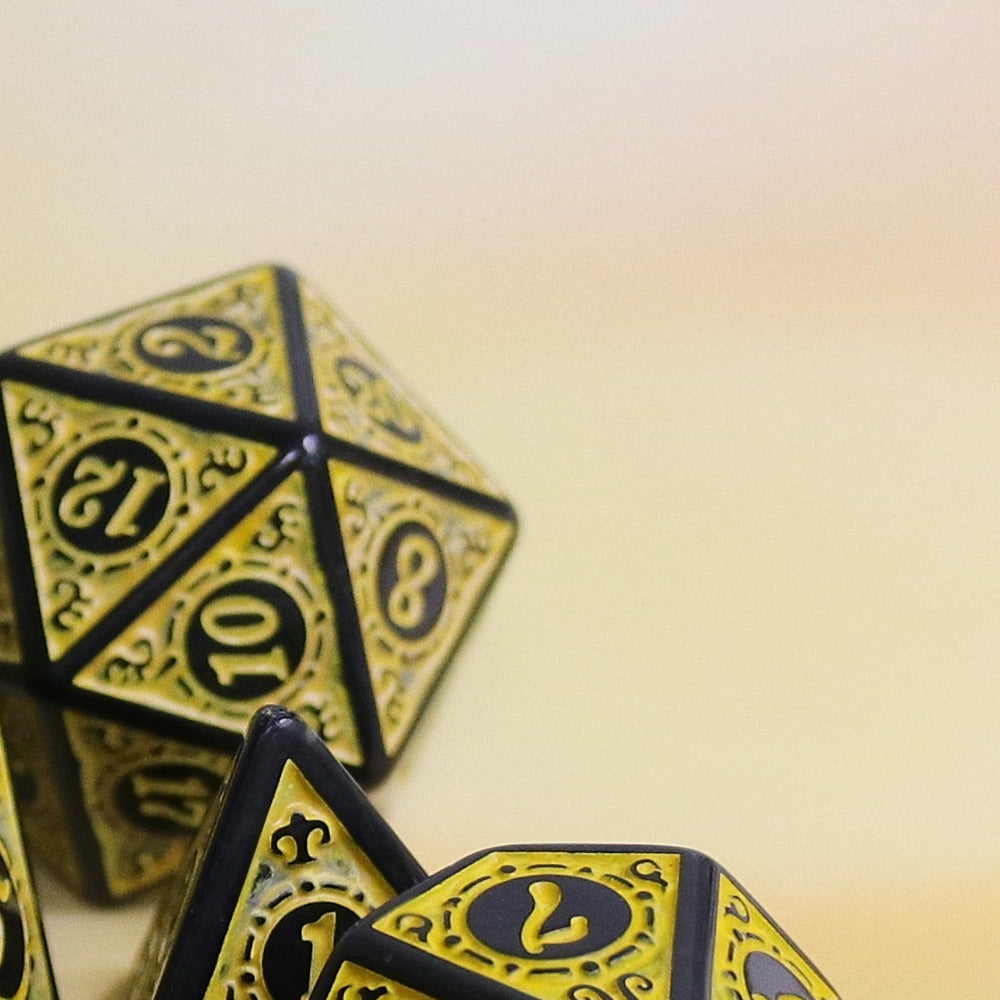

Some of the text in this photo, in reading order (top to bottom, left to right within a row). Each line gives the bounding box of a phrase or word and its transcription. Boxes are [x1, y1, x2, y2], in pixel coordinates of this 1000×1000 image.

[139, 324, 250, 363] 2
[59, 455, 167, 538] 12
[388, 533, 439, 630] 8
[200, 599, 291, 687] 10
